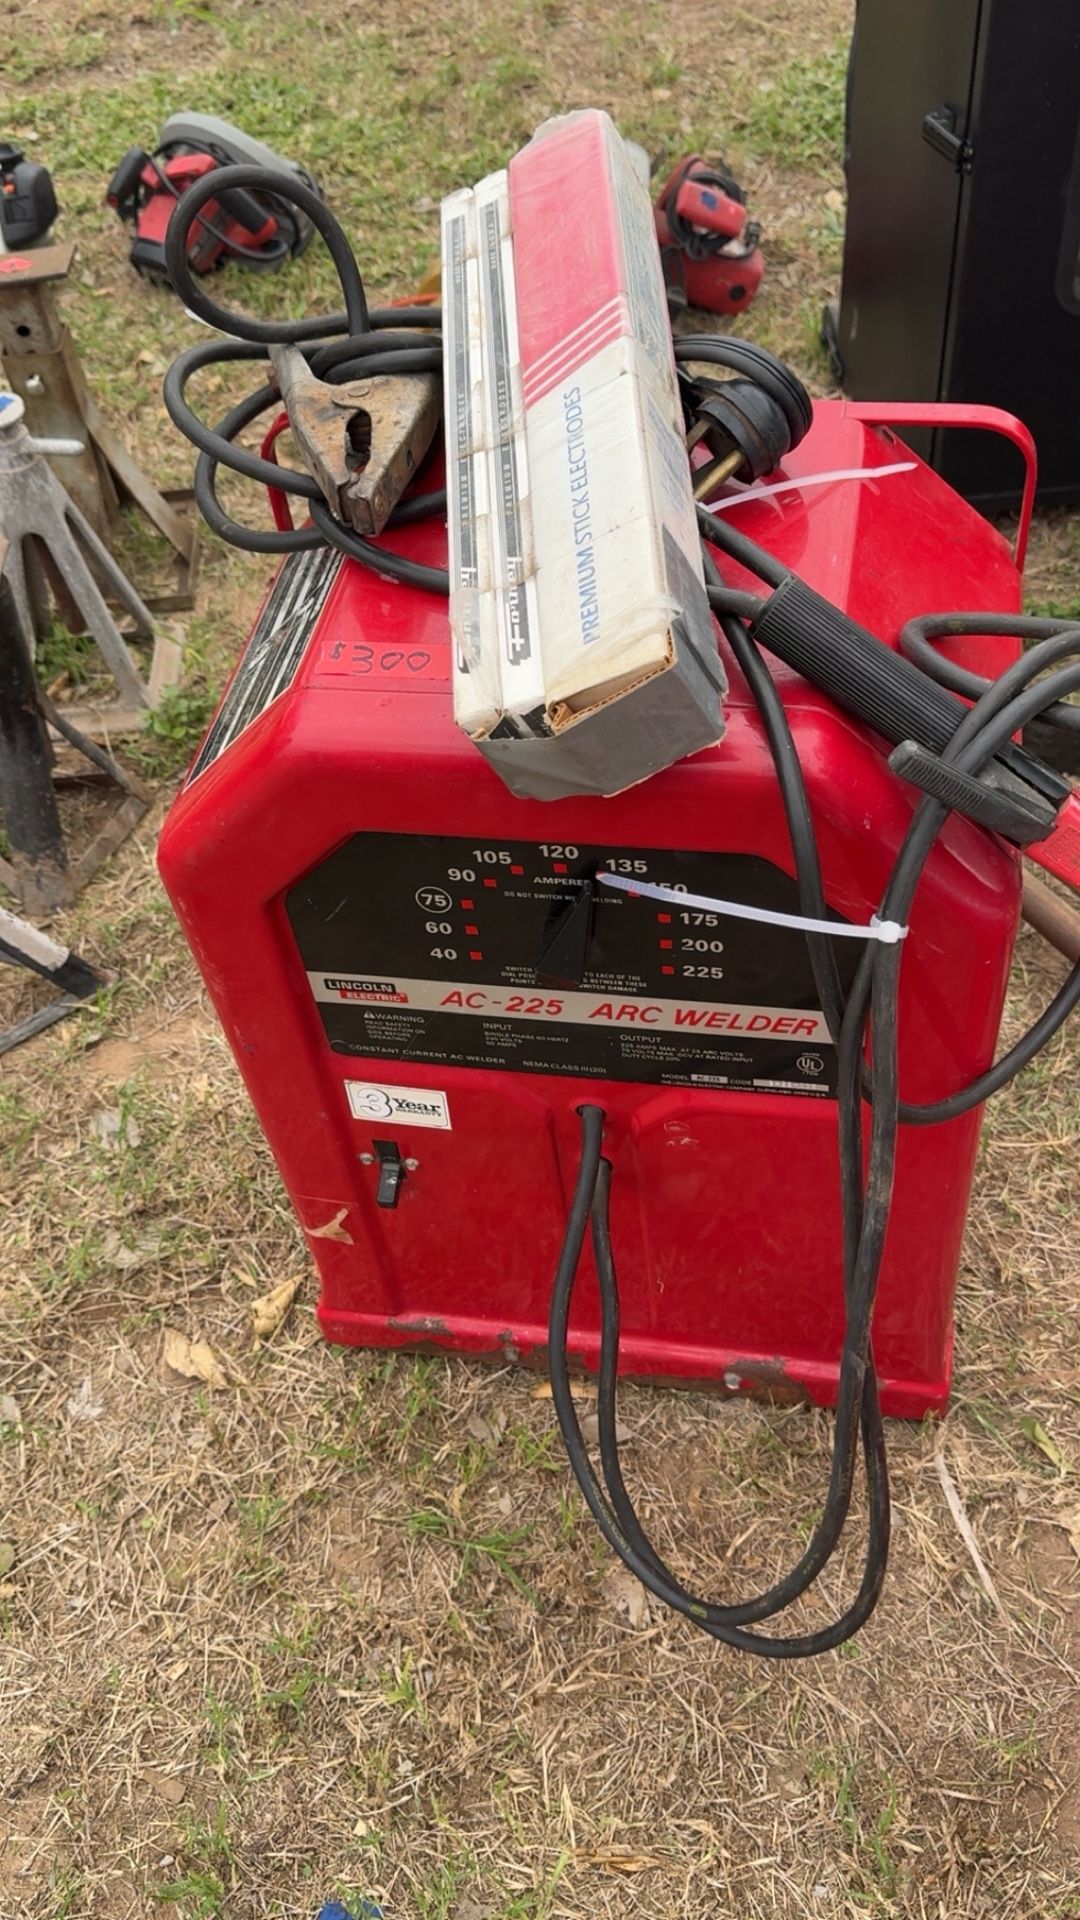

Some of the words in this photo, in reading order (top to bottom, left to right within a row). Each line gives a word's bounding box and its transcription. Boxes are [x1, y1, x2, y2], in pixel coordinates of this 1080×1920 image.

[563, 386, 587, 491] ELECTRODES
[572, 491, 593, 545] STICK
[576, 546, 600, 646] PREMIUM
[329, 641, 431, 674] $300
[472, 850, 512, 865] 105
[538, 844, 579, 859] 120
[606, 858, 648, 873] 135
[447, 868, 476, 882] 90
[420, 893, 447, 907] 75
[679, 912, 718, 927] 175
[425, 921, 452, 935] 60
[681, 939, 724, 953] 200
[430, 948, 457, 960] 40
[682, 965, 724, 980] 225
[327, 980, 393, 992] LINCOLN
[346, 991, 402, 1002] ELECTRIC
[374, 1012, 425, 1023] WARNING
[440, 990, 565, 1015] AC-225
[588, 1002, 664, 1023] ARC
[673, 1008, 818, 1036] WELDER
[483, 1022, 512, 1031] INPUT
[620, 1034, 662, 1043] OUTPUT
[349, 1043, 400, 1055] CONSTANT
[402, 1048, 448, 1059] CURRENT
[450, 1053, 464, 1061] AC
[466, 1054, 506, 1065] WELDER
[522, 1059, 550, 1069] NEMA
[550, 1062, 581, 1073] CLASS
[800, 1057, 819, 1071] UL
[357, 1086, 393, 1119] 3
[392, 1097, 442, 1112] Year
[394, 1107, 443, 1118] WARRANTY
